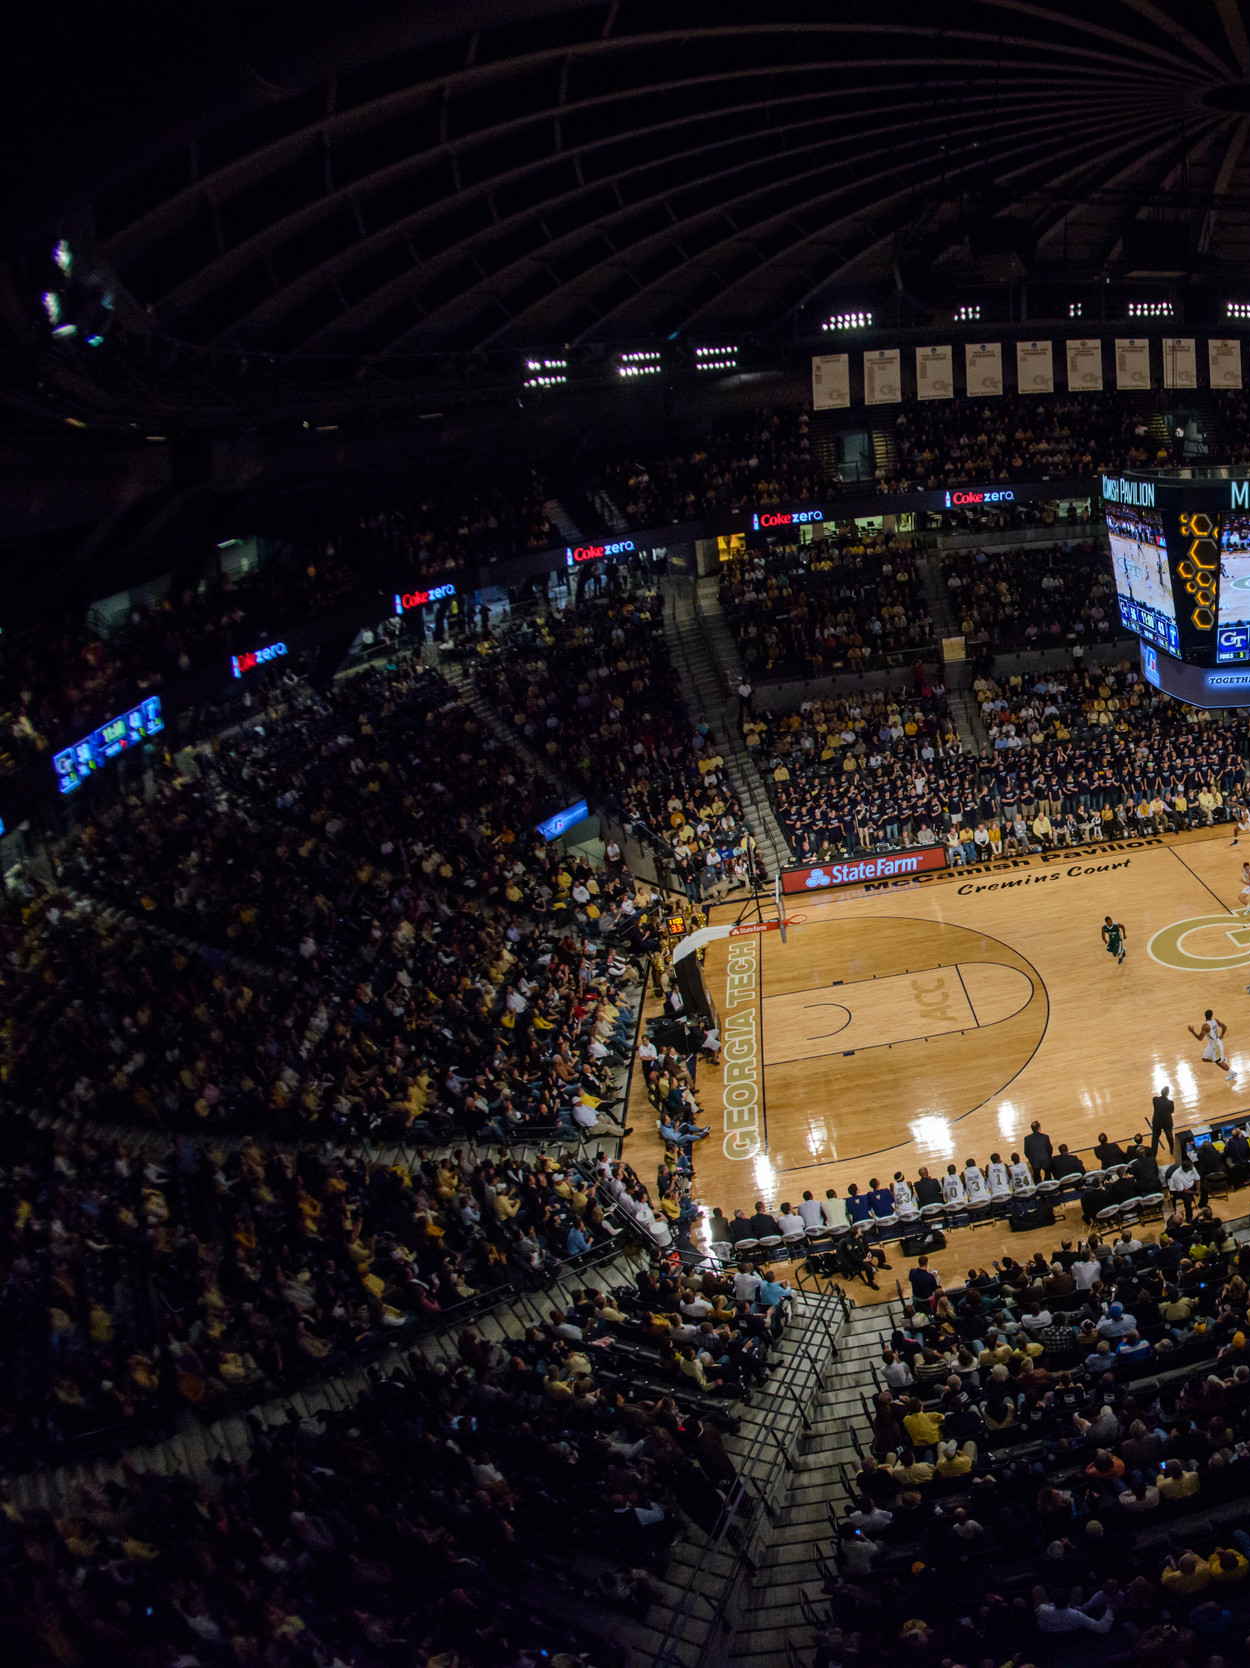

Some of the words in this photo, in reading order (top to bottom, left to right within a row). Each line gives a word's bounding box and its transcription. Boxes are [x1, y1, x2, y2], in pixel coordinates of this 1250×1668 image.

[952, 491, 983, 505] Coke
[984, 491, 1014, 502] zero
[1120, 477, 1154, 507] PAVILION
[760, 511, 791, 527] Coke
[792, 510, 824, 523] zero
[574, 545, 604, 562] Coke
[603, 540, 634, 555] zero
[402, 591, 429, 609] Coke
[427, 584, 456, 601] zero
[864, 858, 1030, 892] McCamish
[1040, 838, 1164, 862] Pavilion
[957, 872, 1060, 896] Cremins
[1066, 858, 1132, 878] Court
[671, 924, 683, 933] 33
[726, 940, 756, 1008] TECH
[911, 978, 957, 1021] ACC
[723, 1008, 760, 1160] GEORGIA
[971, 1180, 980, 1191] 3
[996, 1174, 1002, 1185] 1
[1014, 1175, 1030, 1188] 24
[950, 1187, 958, 1198] 0
